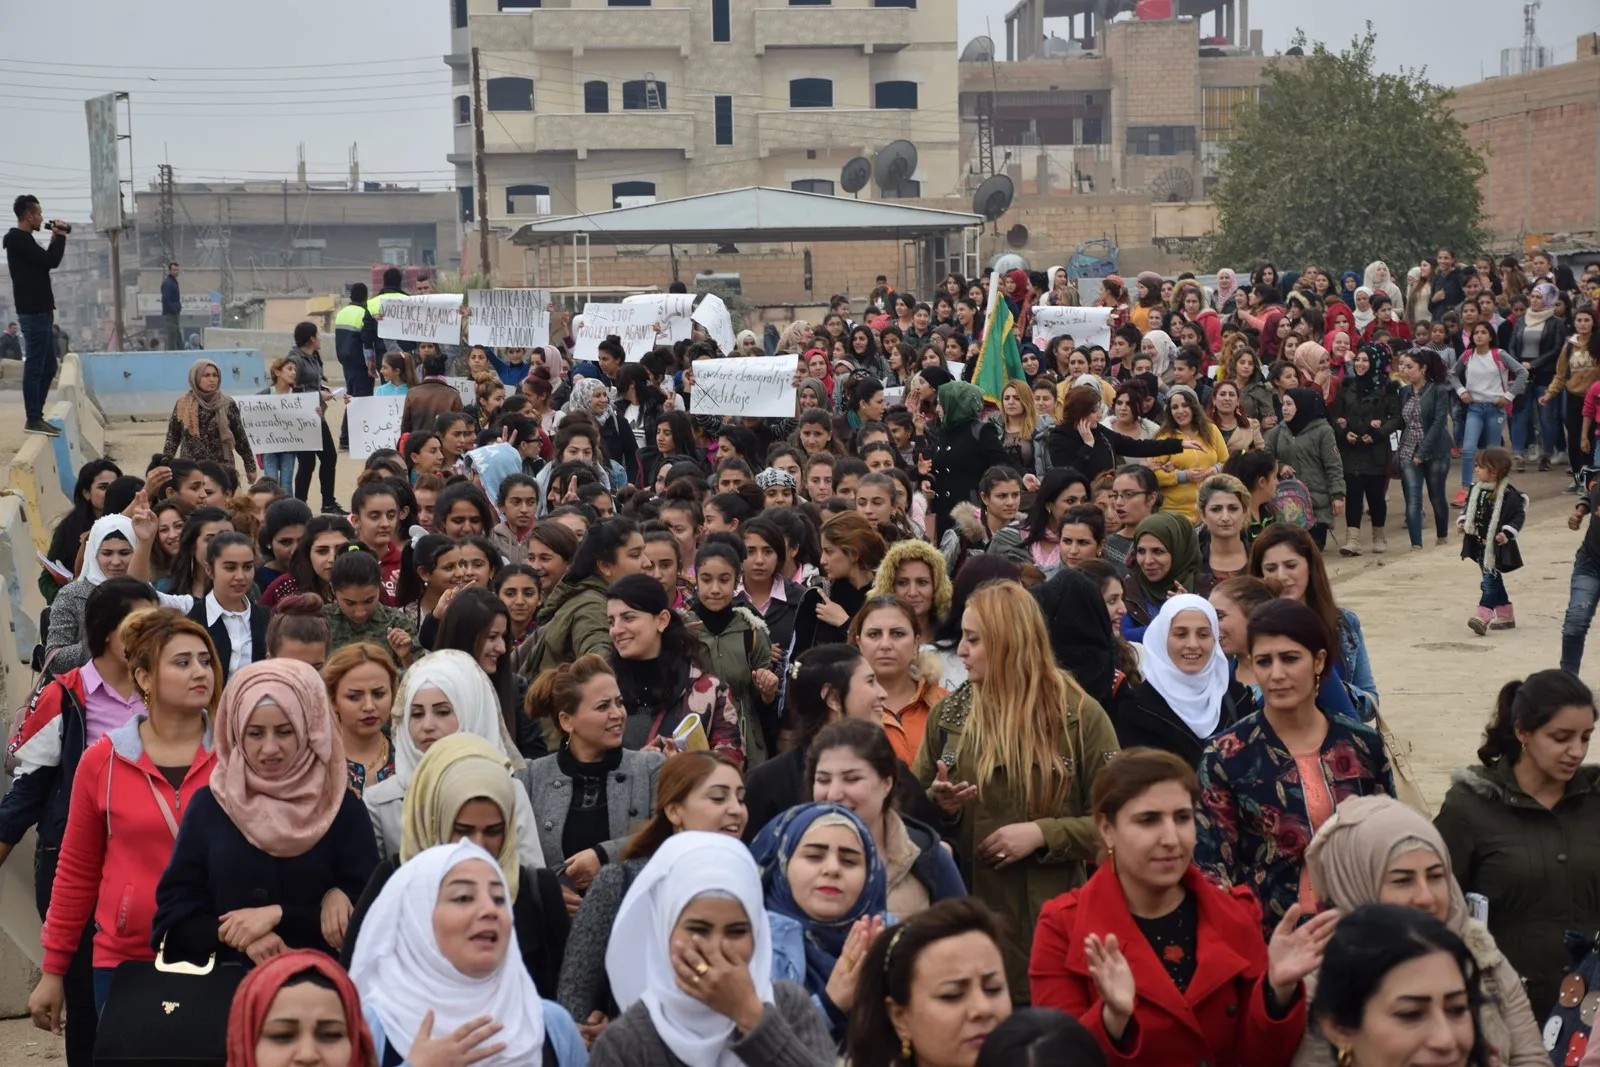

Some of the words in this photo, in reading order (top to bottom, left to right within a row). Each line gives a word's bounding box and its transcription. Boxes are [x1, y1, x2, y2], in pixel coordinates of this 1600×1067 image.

[380, 304, 420, 321] VIOLENCE
[426, 306, 459, 325] AGAINST
[611, 308, 635, 322] STOP
[401, 321, 437, 337] WOMEN
